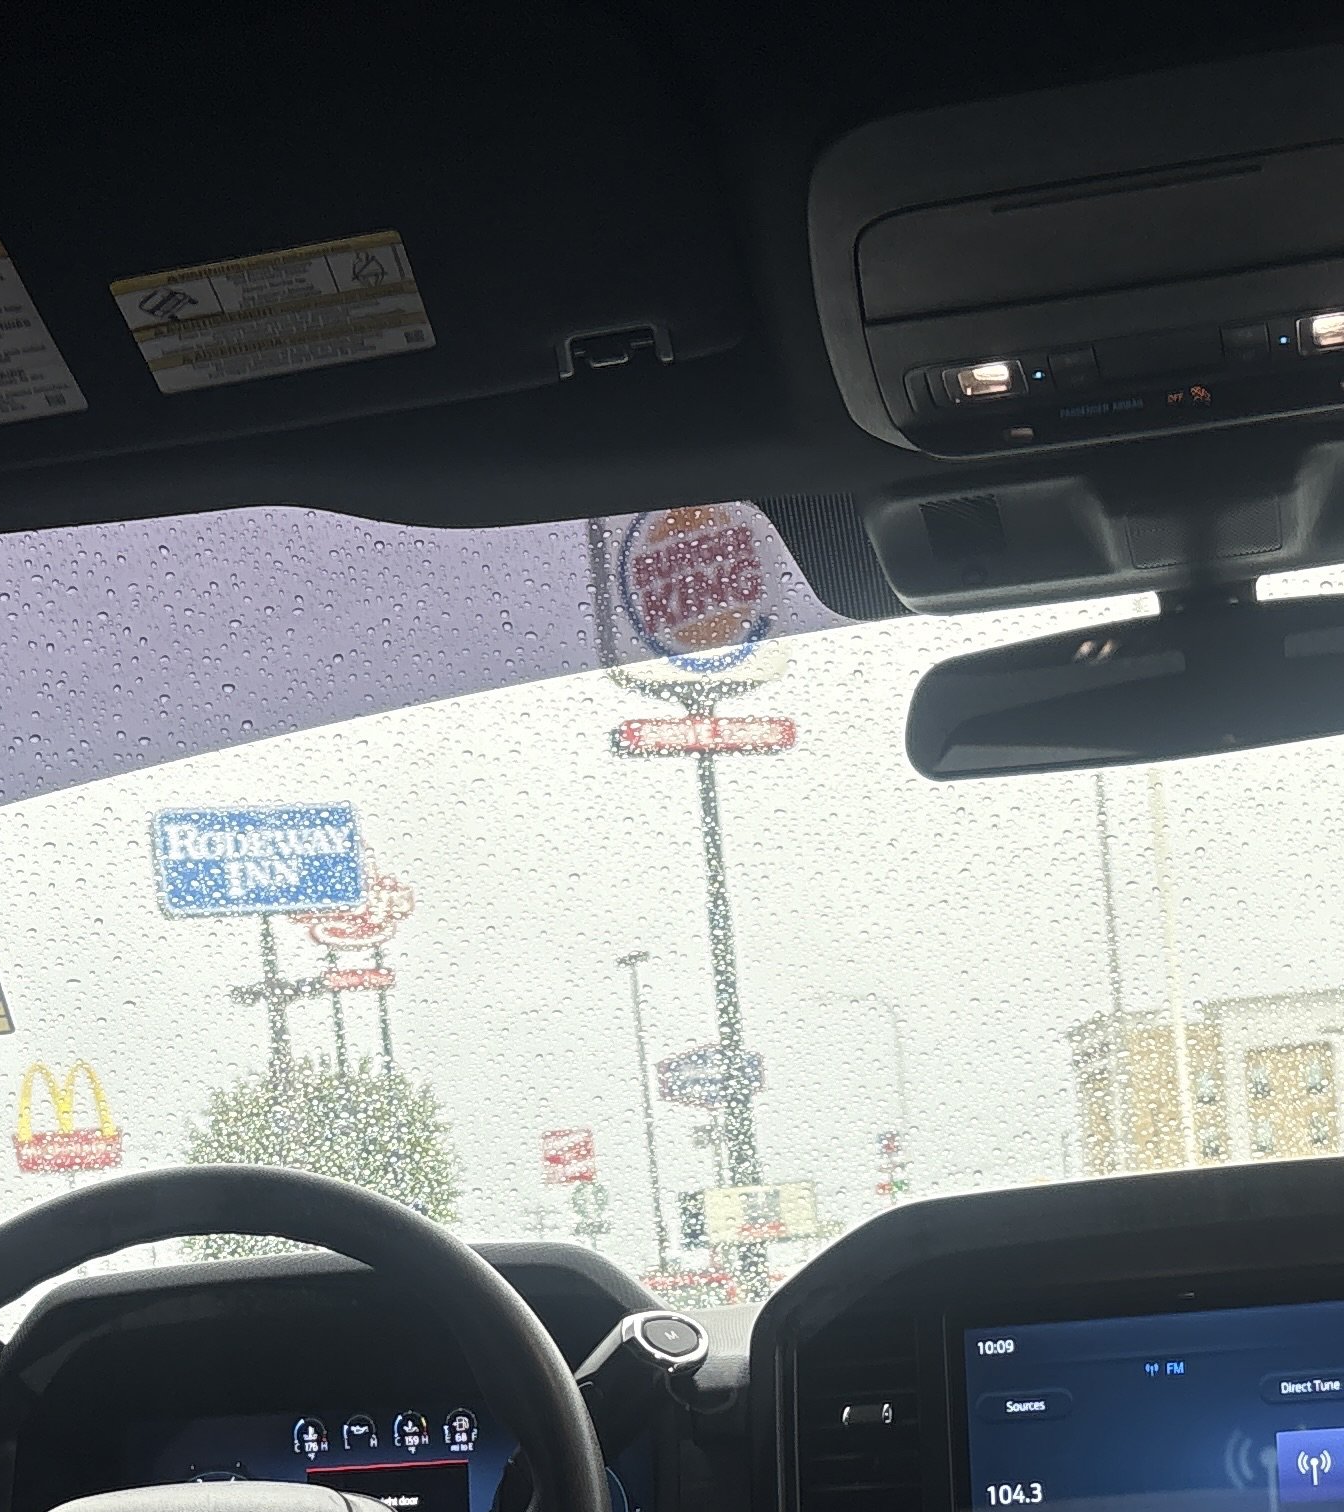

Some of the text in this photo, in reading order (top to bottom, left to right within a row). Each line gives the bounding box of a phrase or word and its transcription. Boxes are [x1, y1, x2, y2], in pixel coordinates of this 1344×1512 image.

[643, 558, 762, 634] KING
[226, 860, 300, 893] INN
[977, 1339, 1015, 1355] 10:09
[1166, 1361, 1185, 1375] FM
[1280, 1378, 1341, 1394] Direct Tune
[1005, 1400, 1046, 1413] Sources
[986, 1482, 1043, 1506] 104.3
